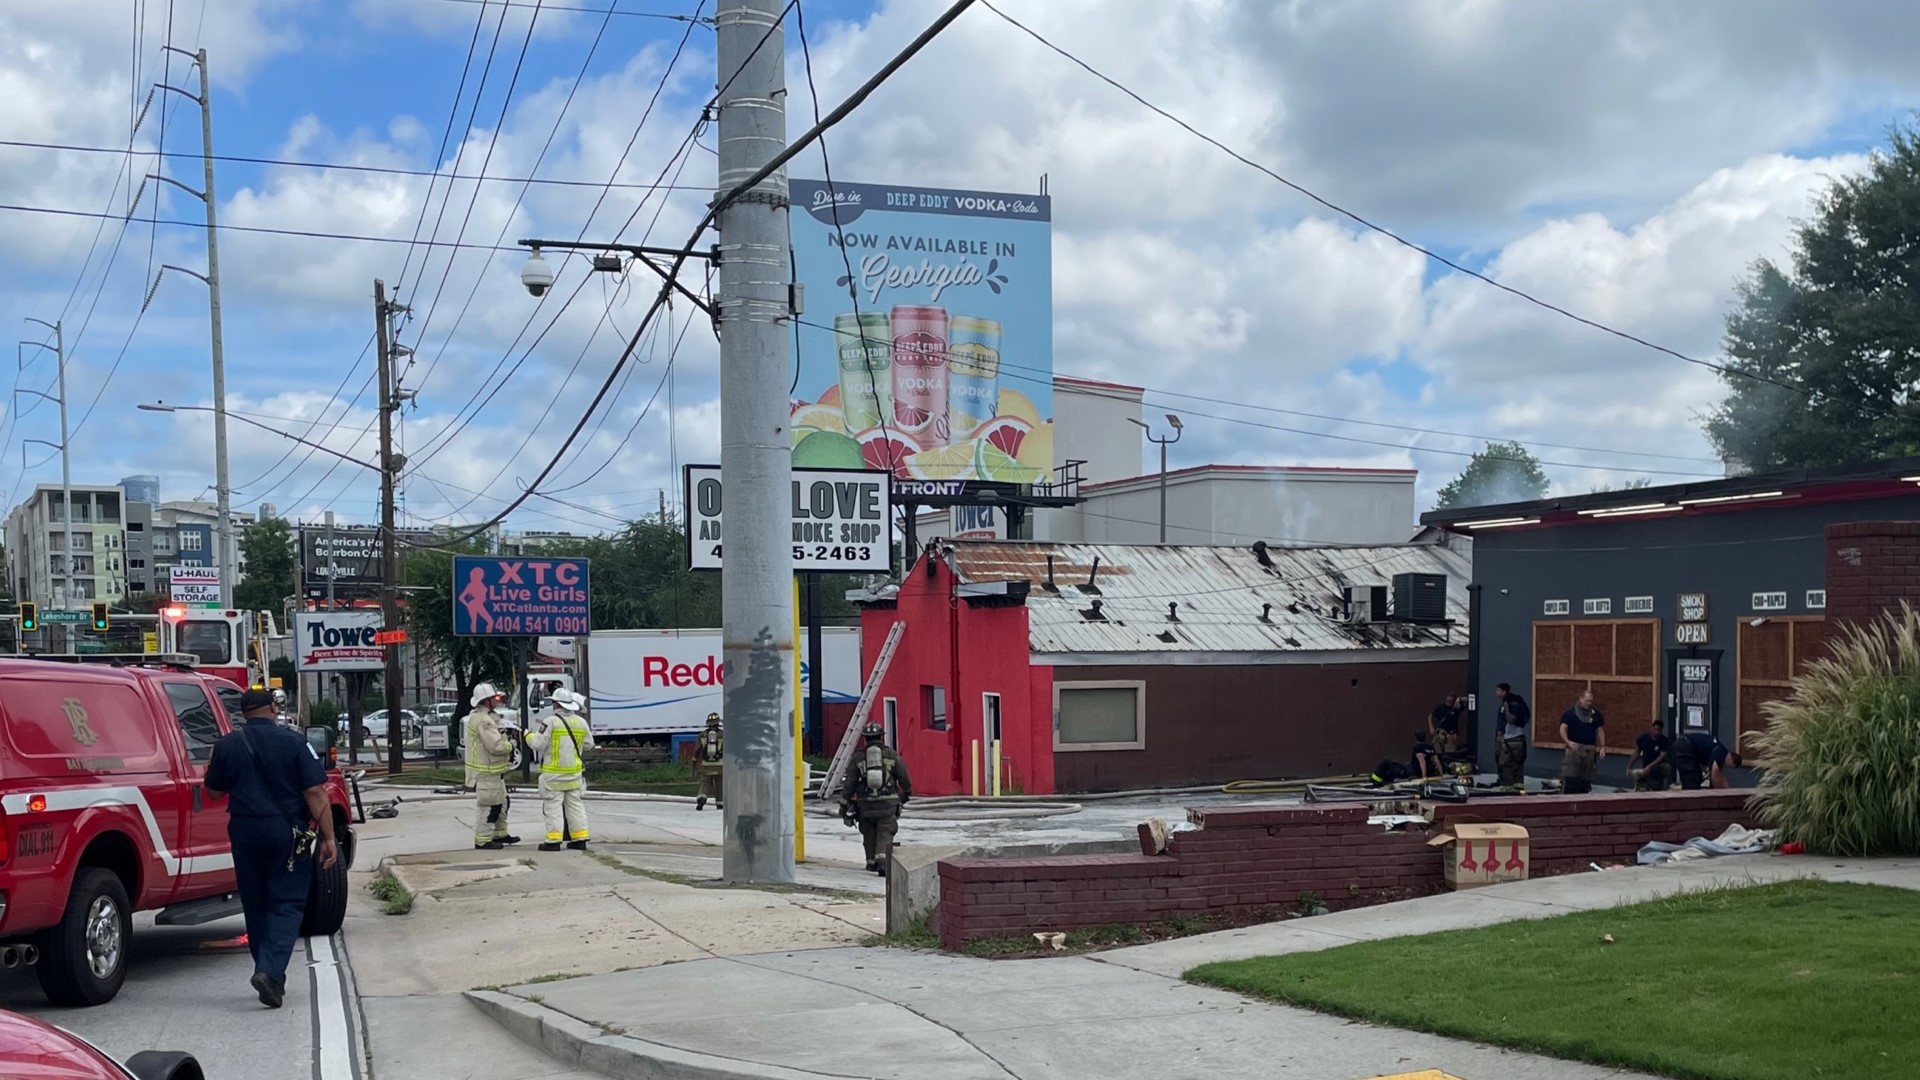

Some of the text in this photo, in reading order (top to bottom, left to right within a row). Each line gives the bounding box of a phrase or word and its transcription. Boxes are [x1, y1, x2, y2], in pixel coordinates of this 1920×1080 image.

[812, 189, 862, 206] Dive in
[886, 192, 916, 207] DEEP
[919, 194, 949, 208] EDDY
[954, 196, 1007, 213] VODKA
[1012, 199, 1039, 214] Soda
[827, 232, 1016, 257] NOW AVAILABLE IN
[860, 252, 983, 304] Georgia
[898, 378, 944, 389] VODKA
[792, 480, 881, 520] LOVE
[792, 522, 881, 544] MOKE SHOP
[173, 569, 217, 578] U-HAUL
[498, 562, 580, 585] XTC
[173, 594, 219, 602] STORAGE
[184, 586, 208, 594] SELF
[489, 586, 586, 602] Live Girls
[41, 612, 88, 620] Lakeshore Dr
[492, 602, 587, 614] XTCatlanta.com
[1683, 607, 1704, 620] SHOP
[495, 616, 587, 633] 404 541 0901
[1677, 624, 1707, 643] OPEN
[359, 650, 383, 658] Spirits
[1684, 666, 1707, 679] 2145
